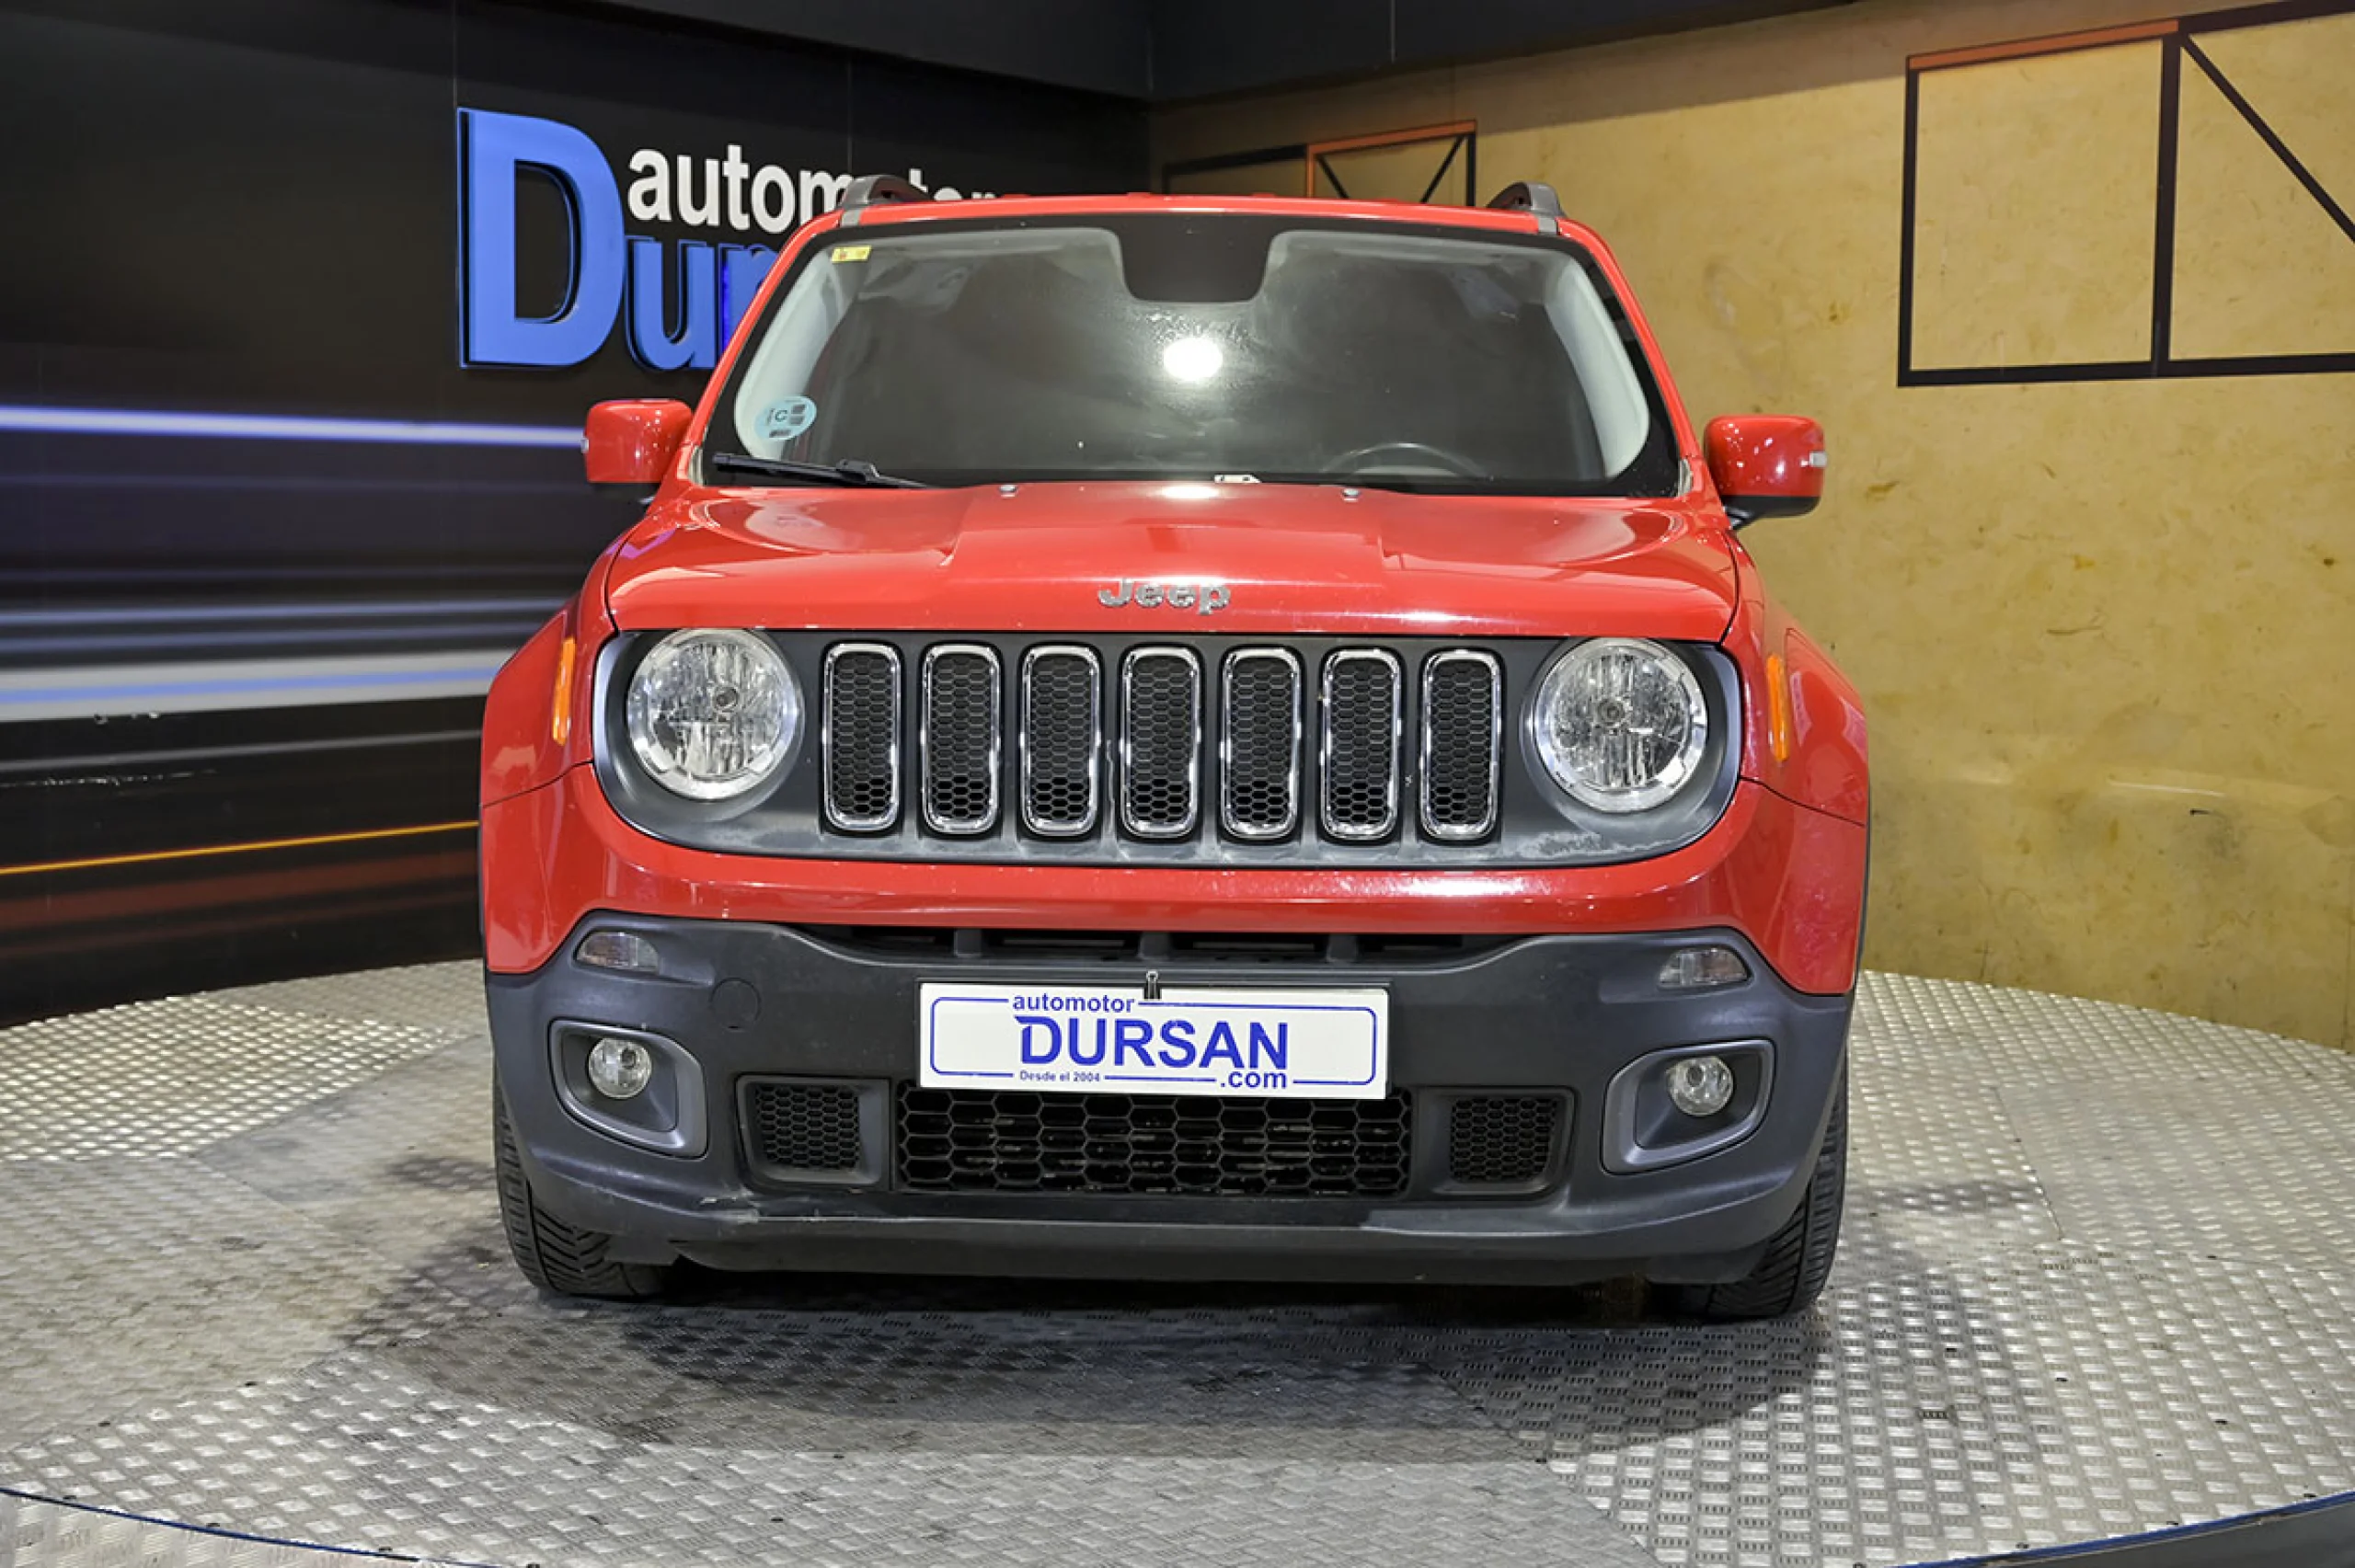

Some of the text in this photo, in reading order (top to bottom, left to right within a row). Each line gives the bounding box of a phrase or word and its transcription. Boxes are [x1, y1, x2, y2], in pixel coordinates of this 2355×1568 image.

[1097, 578, 1232, 615] Jeep
[1012, 992, 1135, 1013] automotor
[1014, 1015, 1289, 1070] DURSAN
[1019, 1070, 1100, 1083] Desde el 2004
[1220, 1070, 1288, 1090] .com
